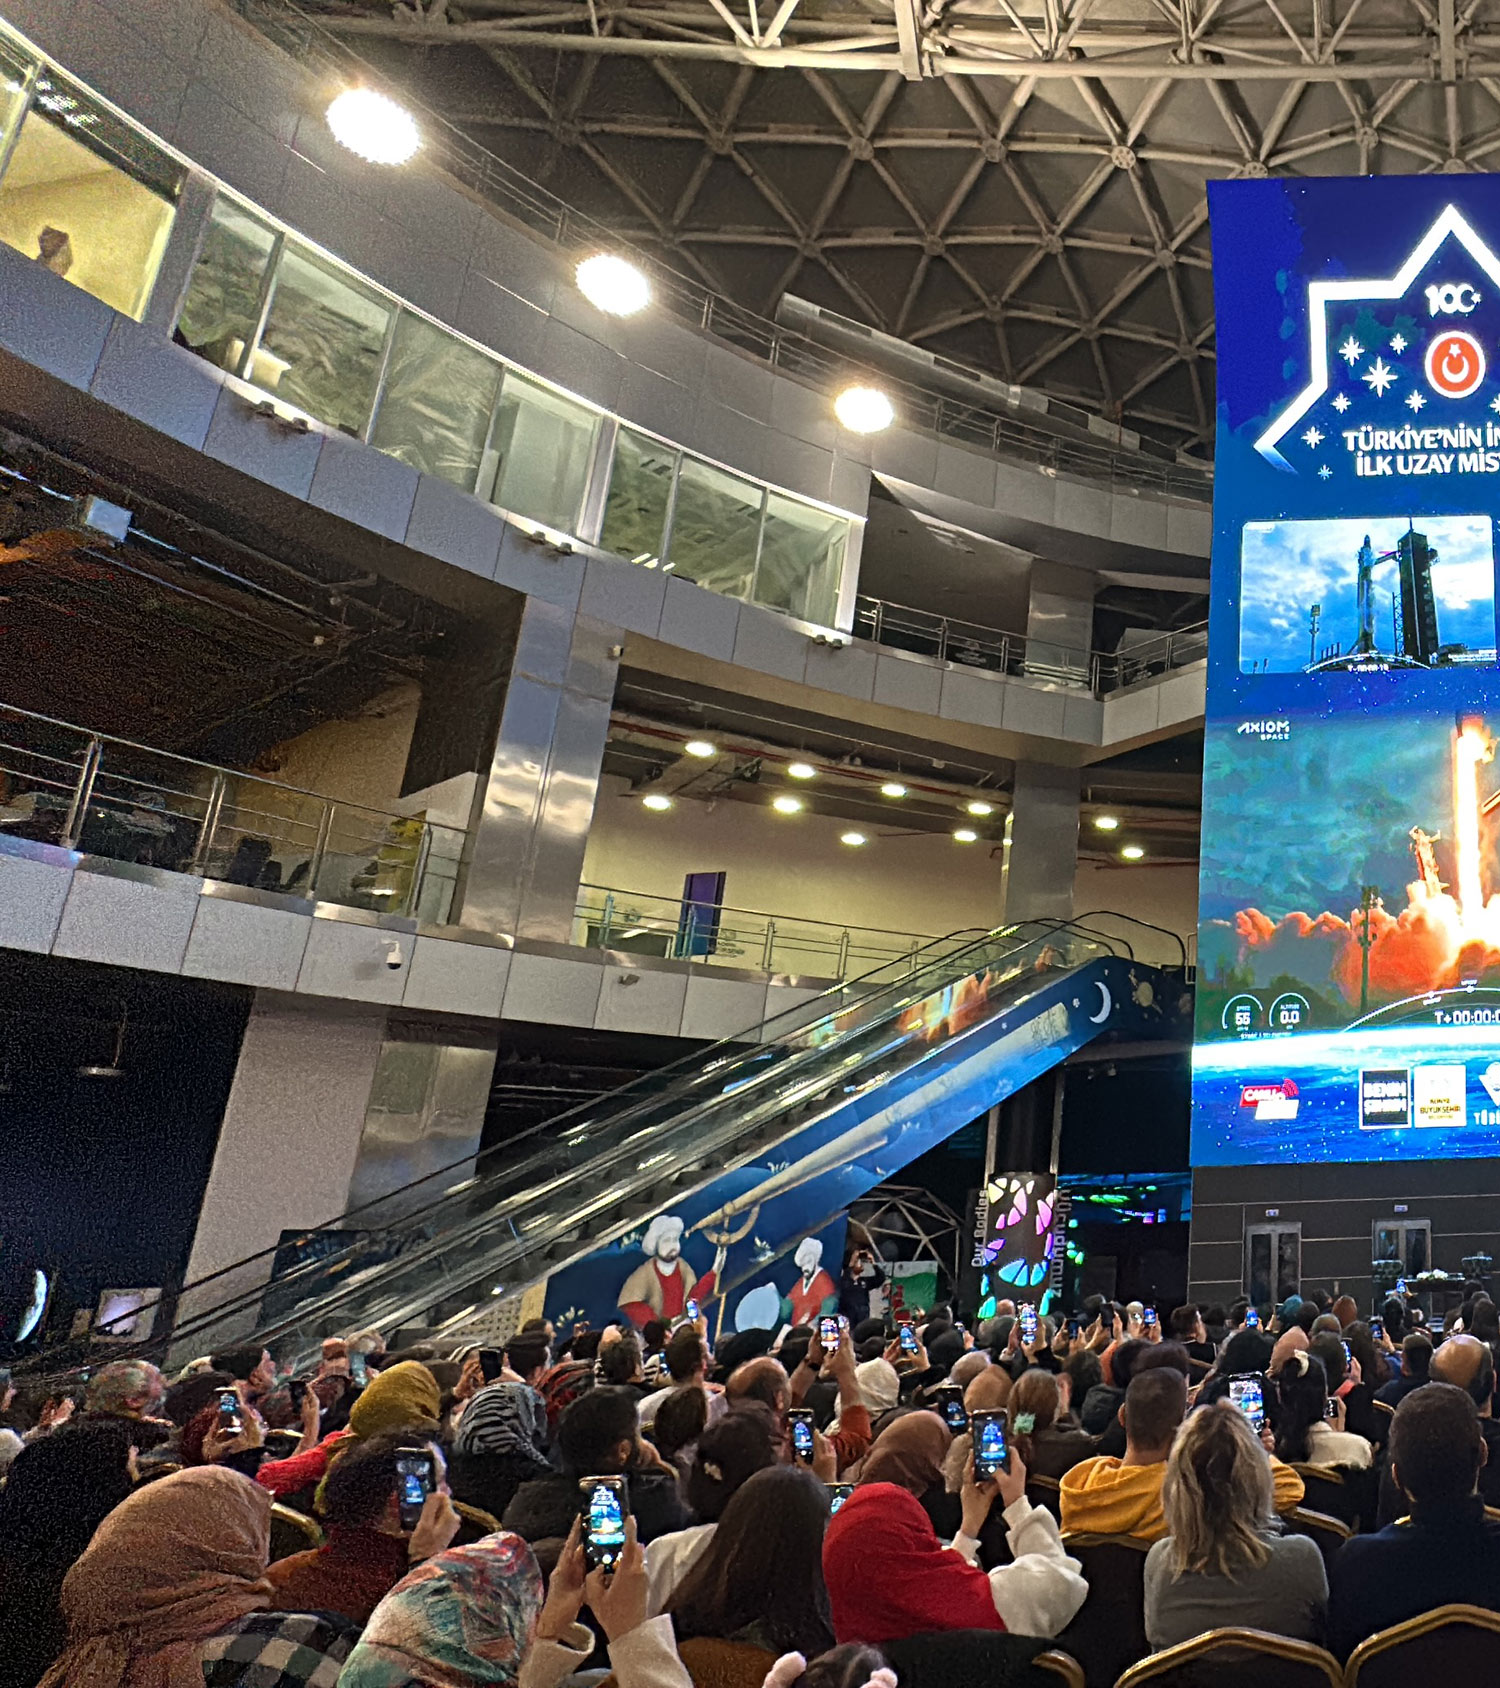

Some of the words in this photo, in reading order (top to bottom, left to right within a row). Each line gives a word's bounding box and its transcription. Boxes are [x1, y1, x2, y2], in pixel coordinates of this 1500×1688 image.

[1356, 451, 1393, 476] İLK
[1396, 453, 1455, 475] UZAY
[1237, 720, 1290, 734] AXIOM
[1260, 733, 1290, 741] SPACE
